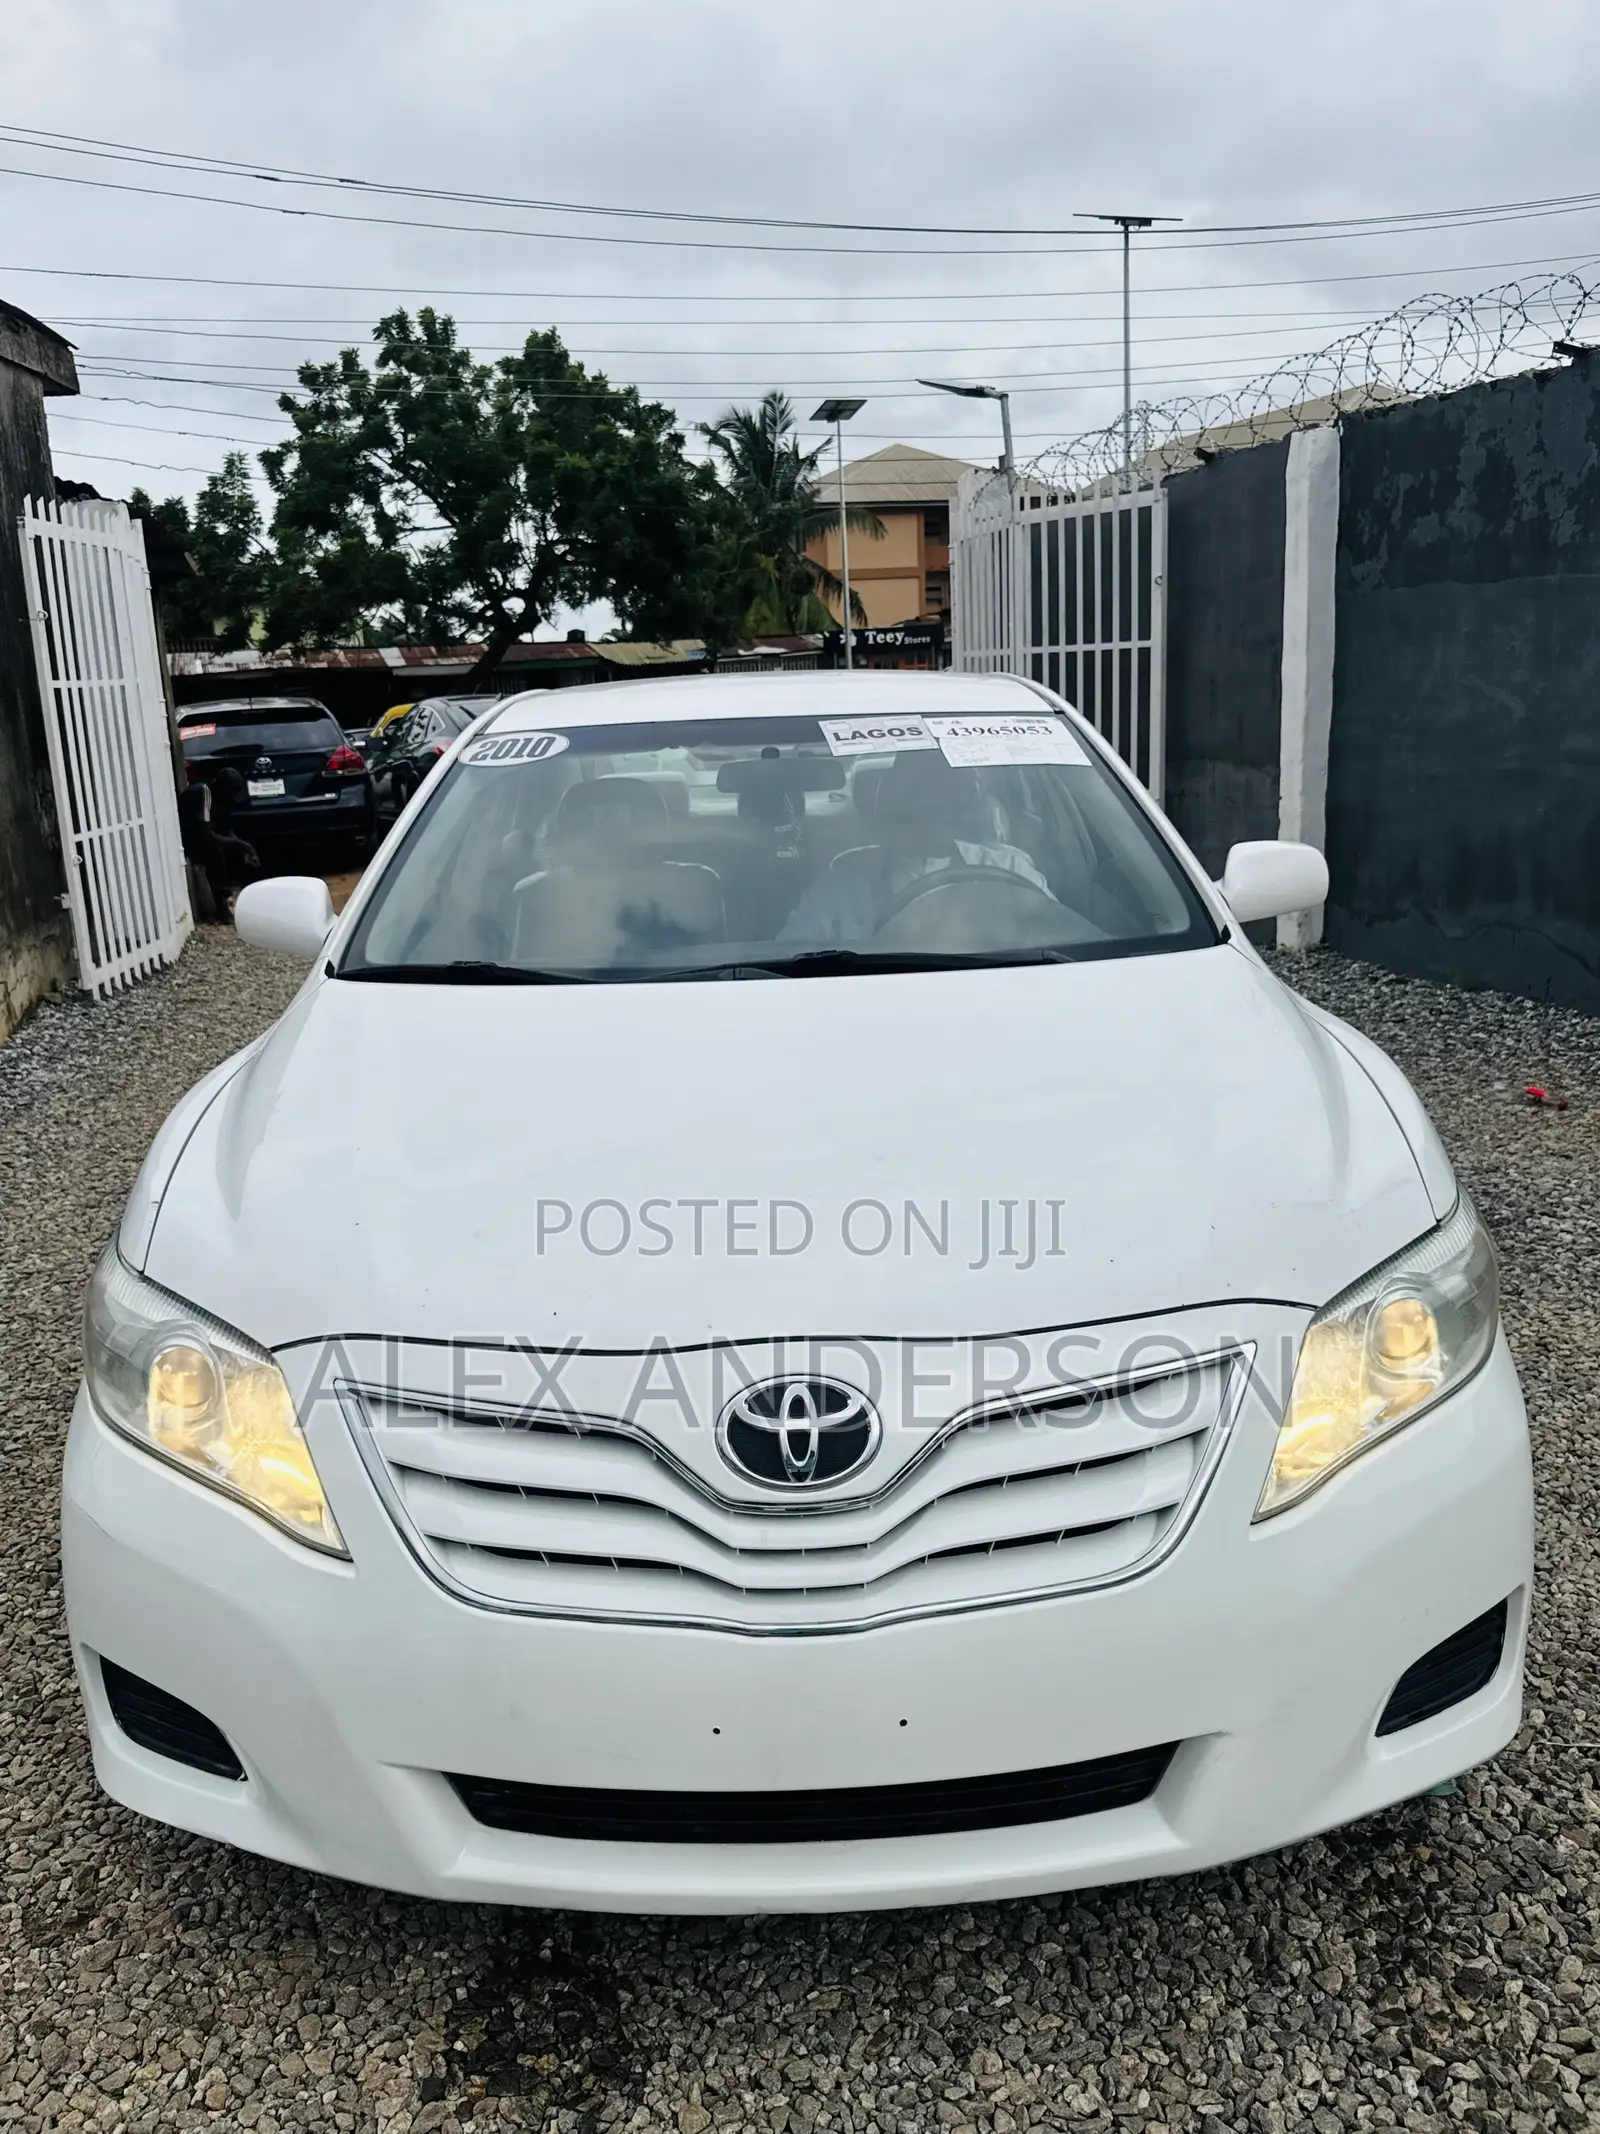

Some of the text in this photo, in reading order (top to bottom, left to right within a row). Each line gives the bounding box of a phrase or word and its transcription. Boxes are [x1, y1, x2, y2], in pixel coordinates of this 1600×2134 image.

[865, 630, 931, 645] Teey Stores
[832, 726, 923, 742] LAGOS
[946, 726, 1053, 737] 43965053
[468, 736, 557, 762] 2010
